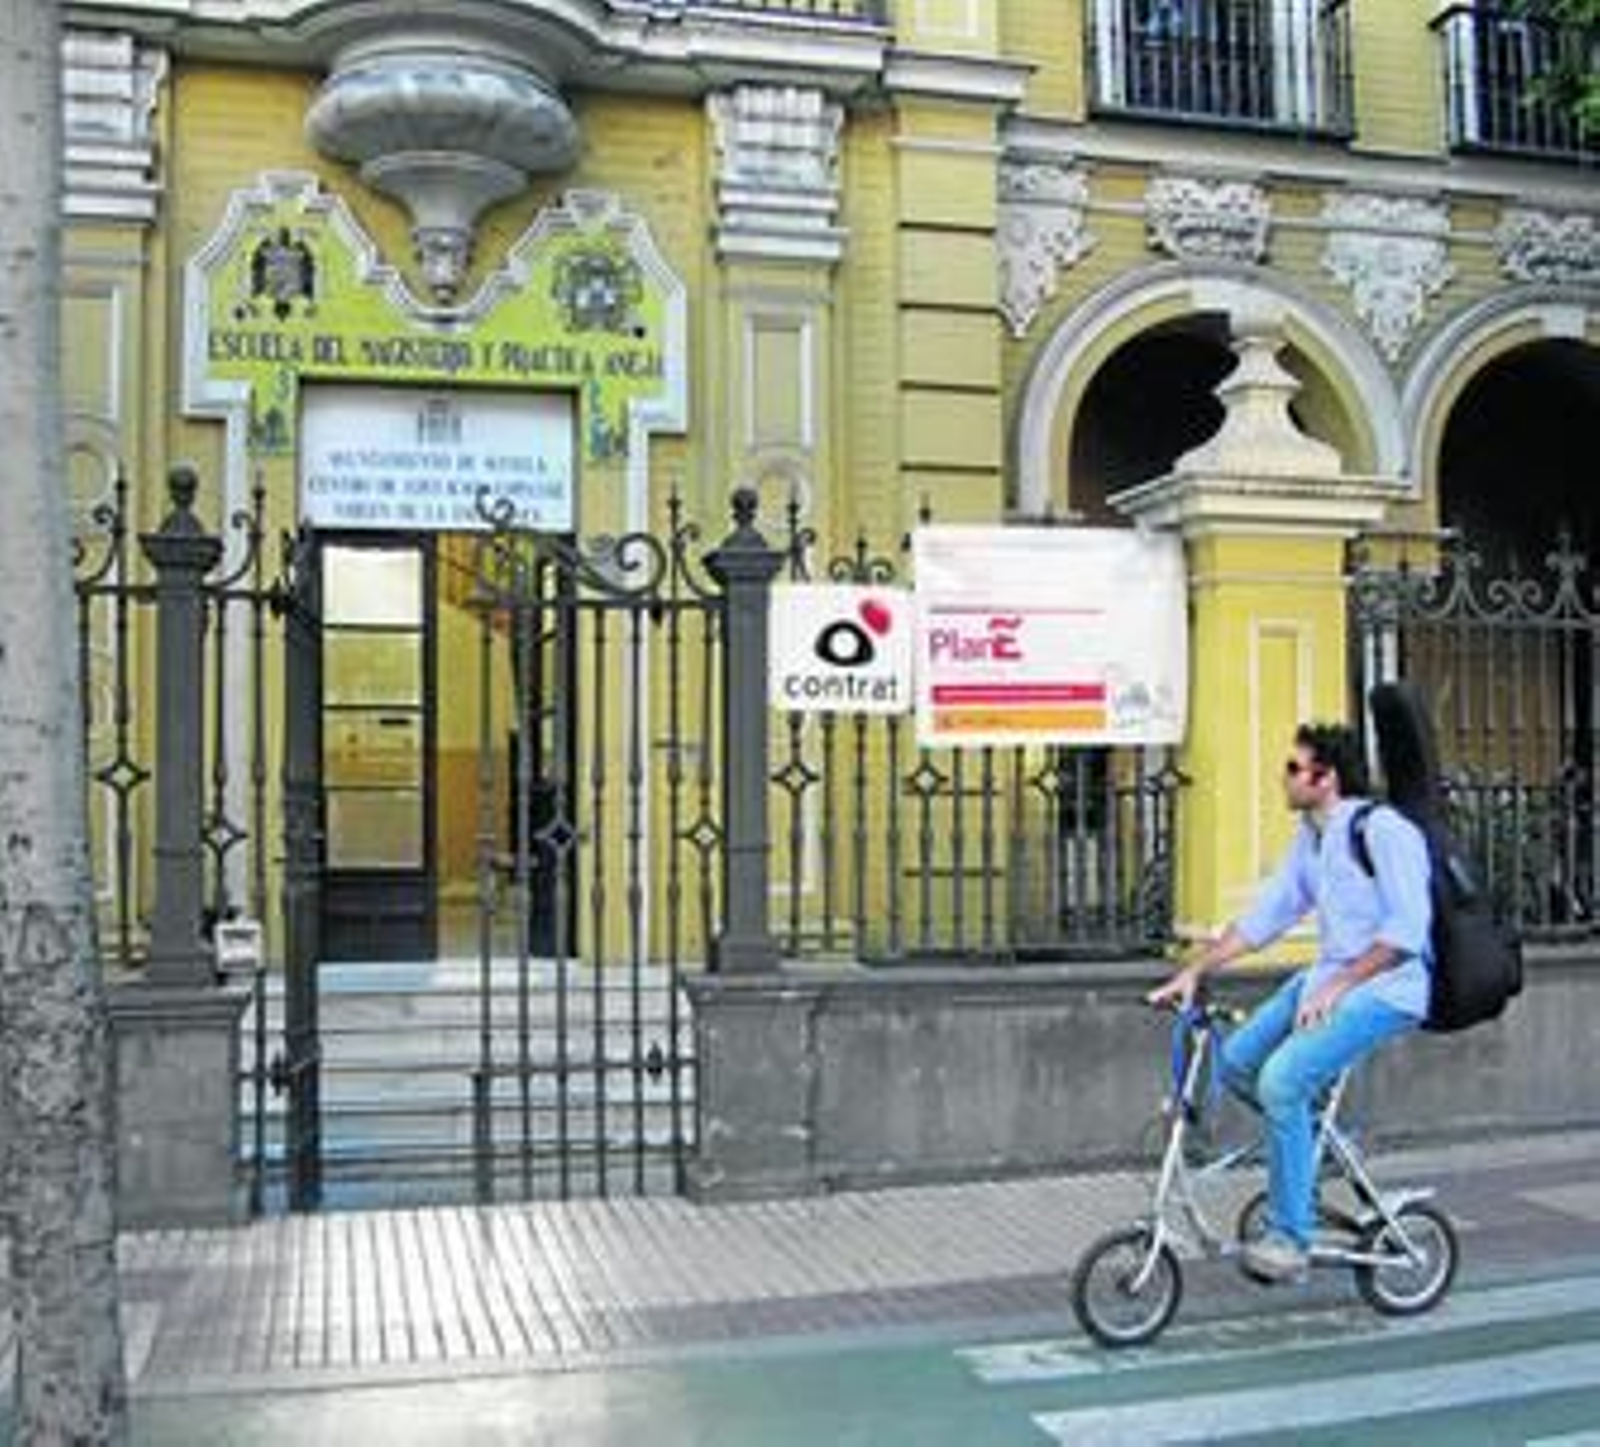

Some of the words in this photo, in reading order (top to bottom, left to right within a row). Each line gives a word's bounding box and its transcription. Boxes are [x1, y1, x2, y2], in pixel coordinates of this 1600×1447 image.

[208, 332, 304, 363] ESCUELA
[313, 335, 347, 367] DEL
[481, 343, 495, 369] Y
